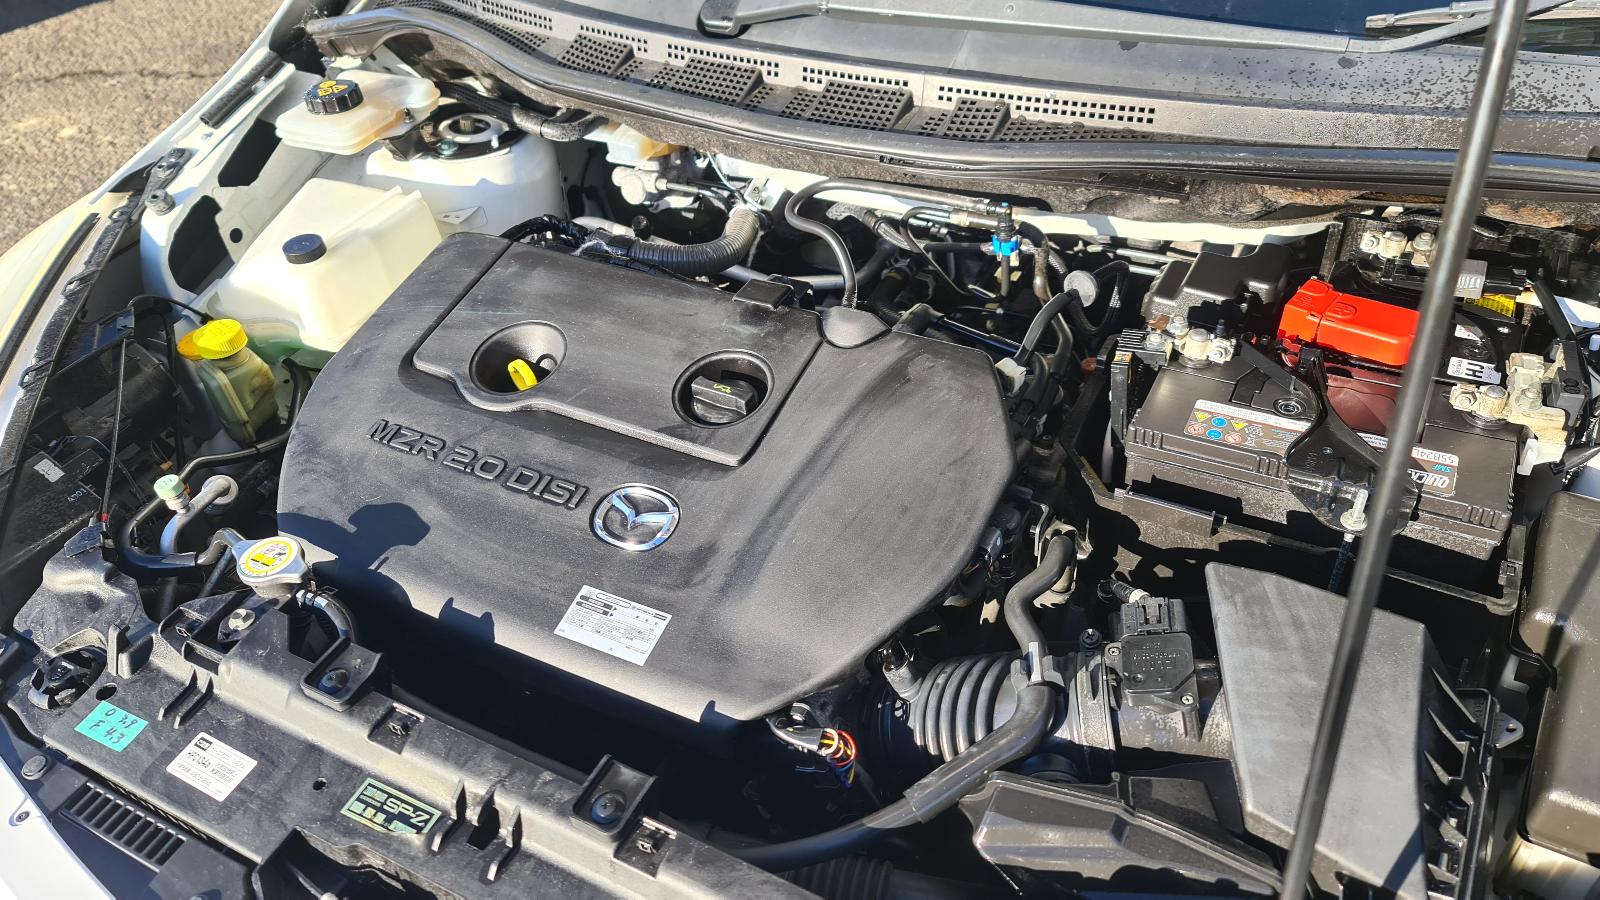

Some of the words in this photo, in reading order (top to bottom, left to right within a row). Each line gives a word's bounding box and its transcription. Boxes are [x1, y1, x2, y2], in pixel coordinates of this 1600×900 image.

[366, 418, 446, 461] MZR
[442, 445, 507, 480] 2.0
[505, 466, 589, 508] DISI
[1413, 448, 1455, 464] 55B24L
[1431, 464, 1453, 473] SMF
